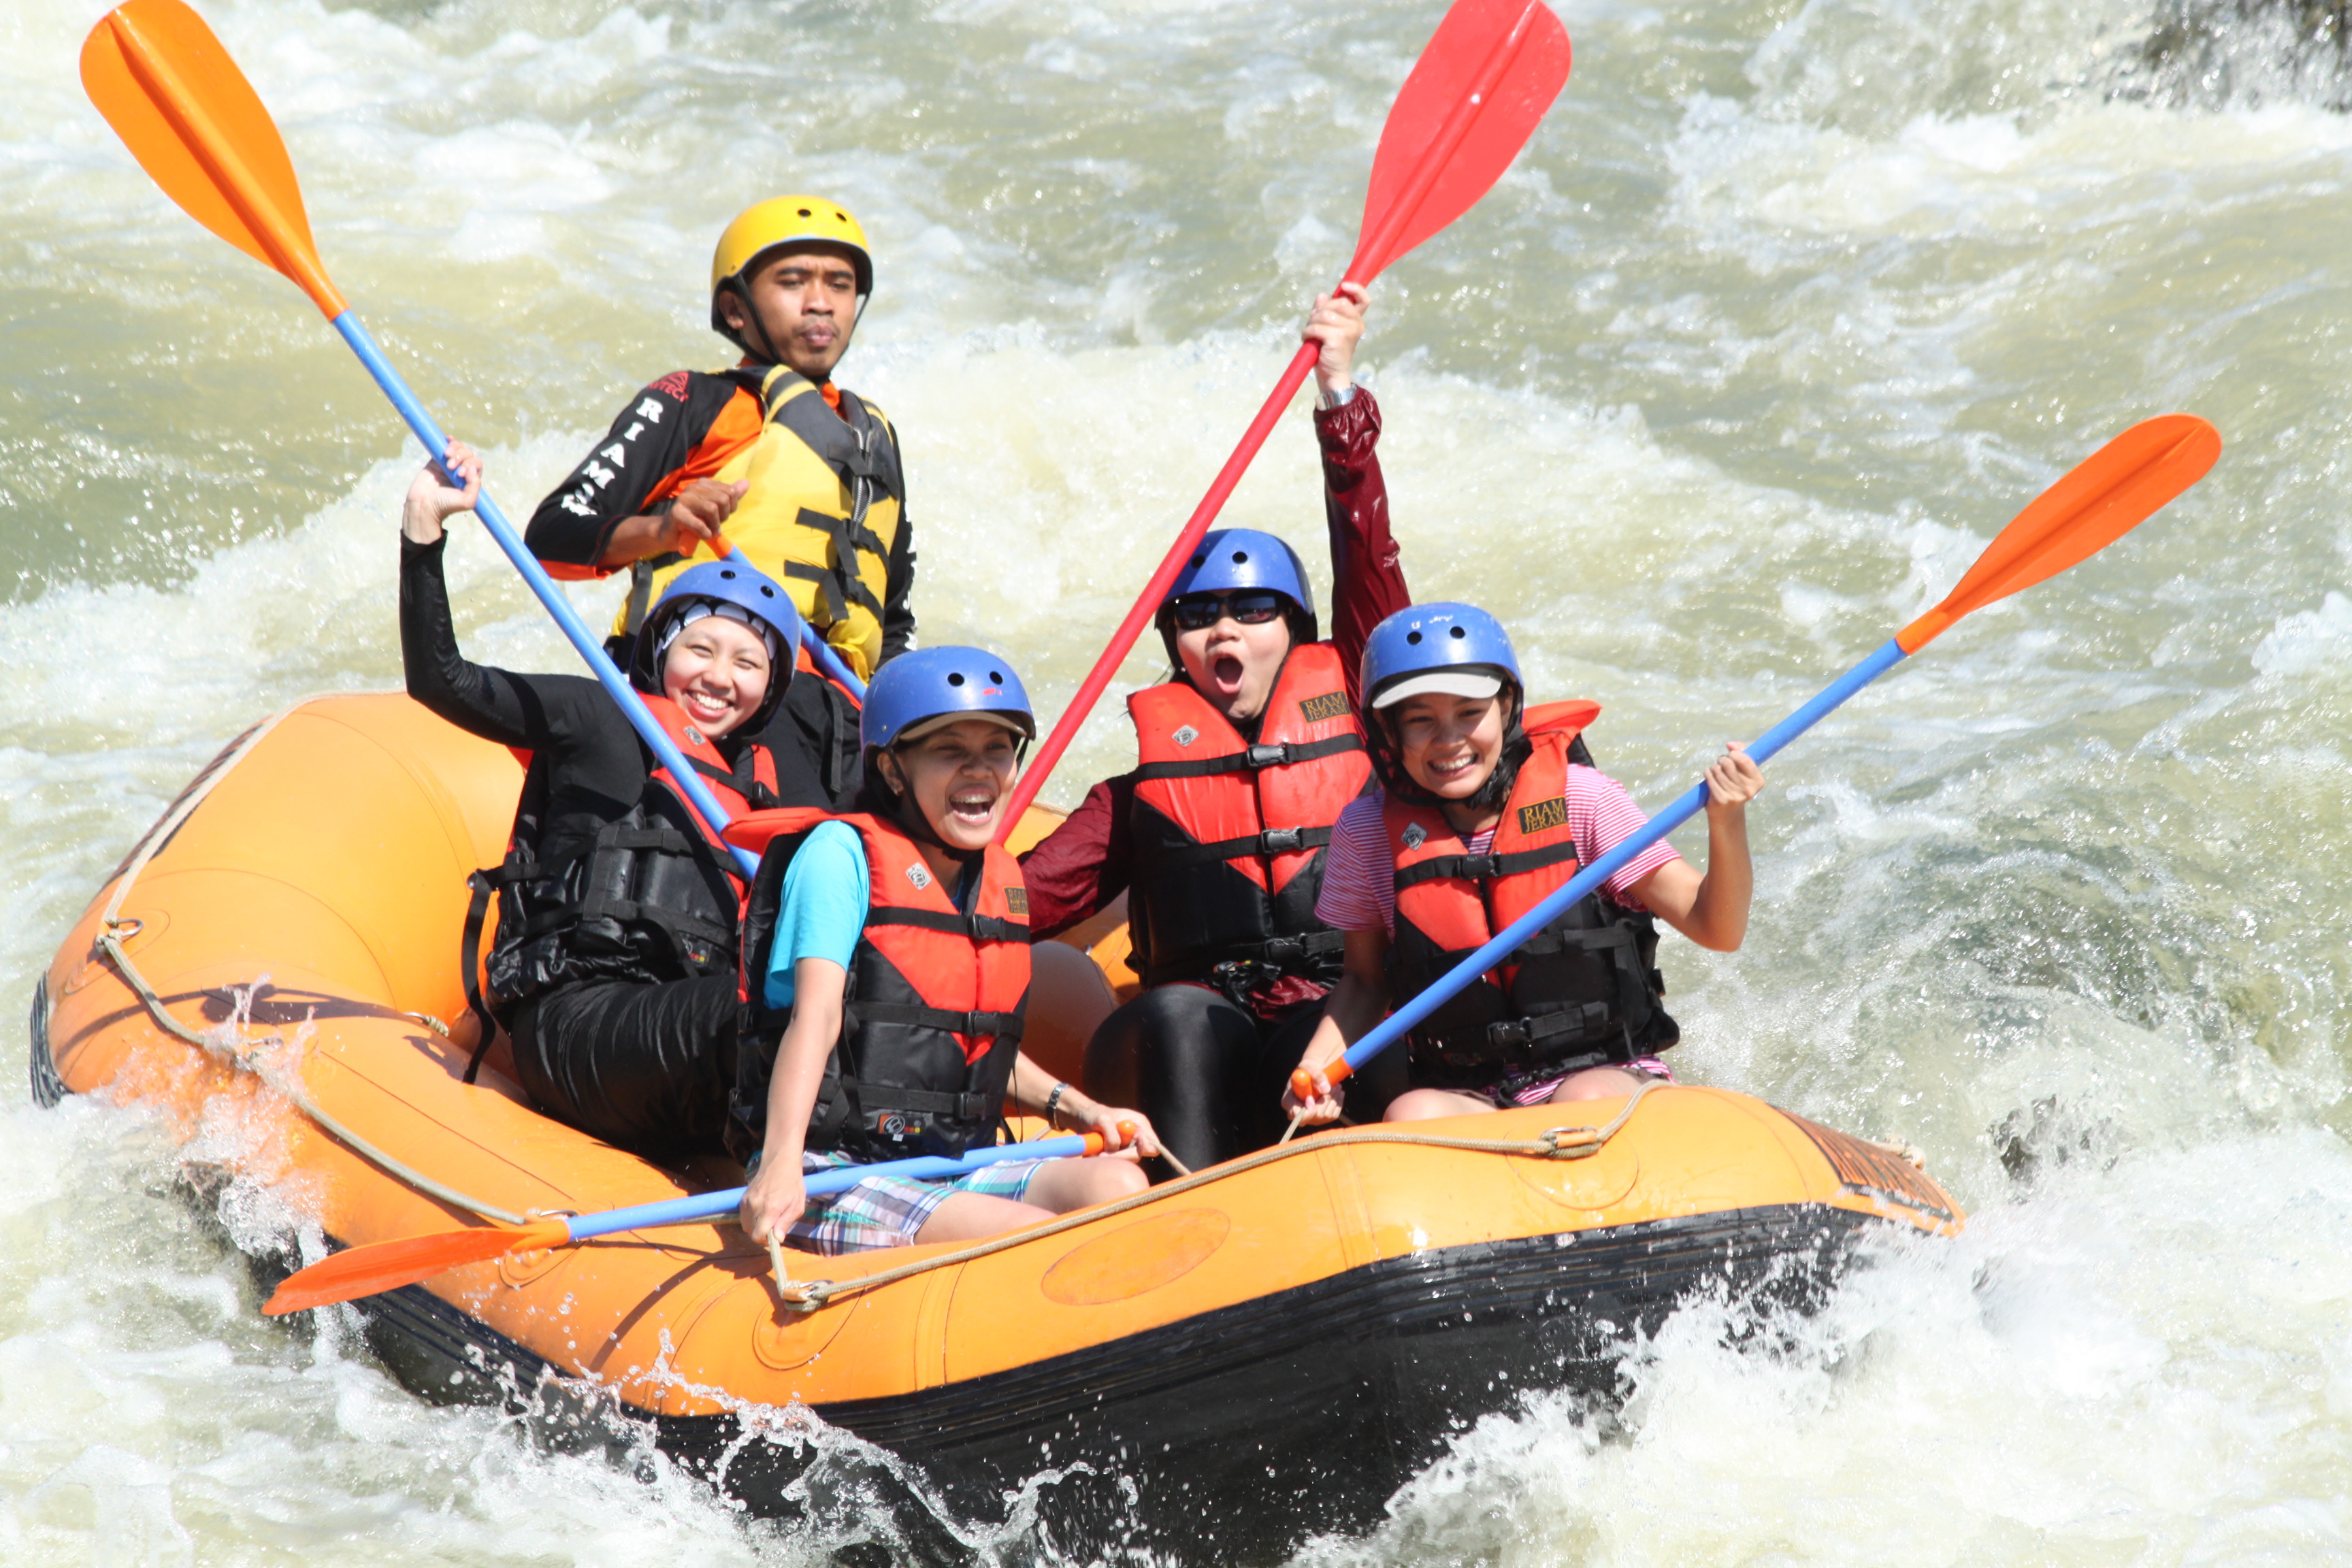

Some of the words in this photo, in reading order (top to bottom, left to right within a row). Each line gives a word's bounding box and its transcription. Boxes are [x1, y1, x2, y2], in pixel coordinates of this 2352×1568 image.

[581, 397, 664, 489] RIAM
[1305, 693, 1345, 712] RIAM
[1308, 703, 1348, 721] JERAM
[1524, 799, 1565, 821] RIAM
[1525, 812, 1567, 833] JERAM
